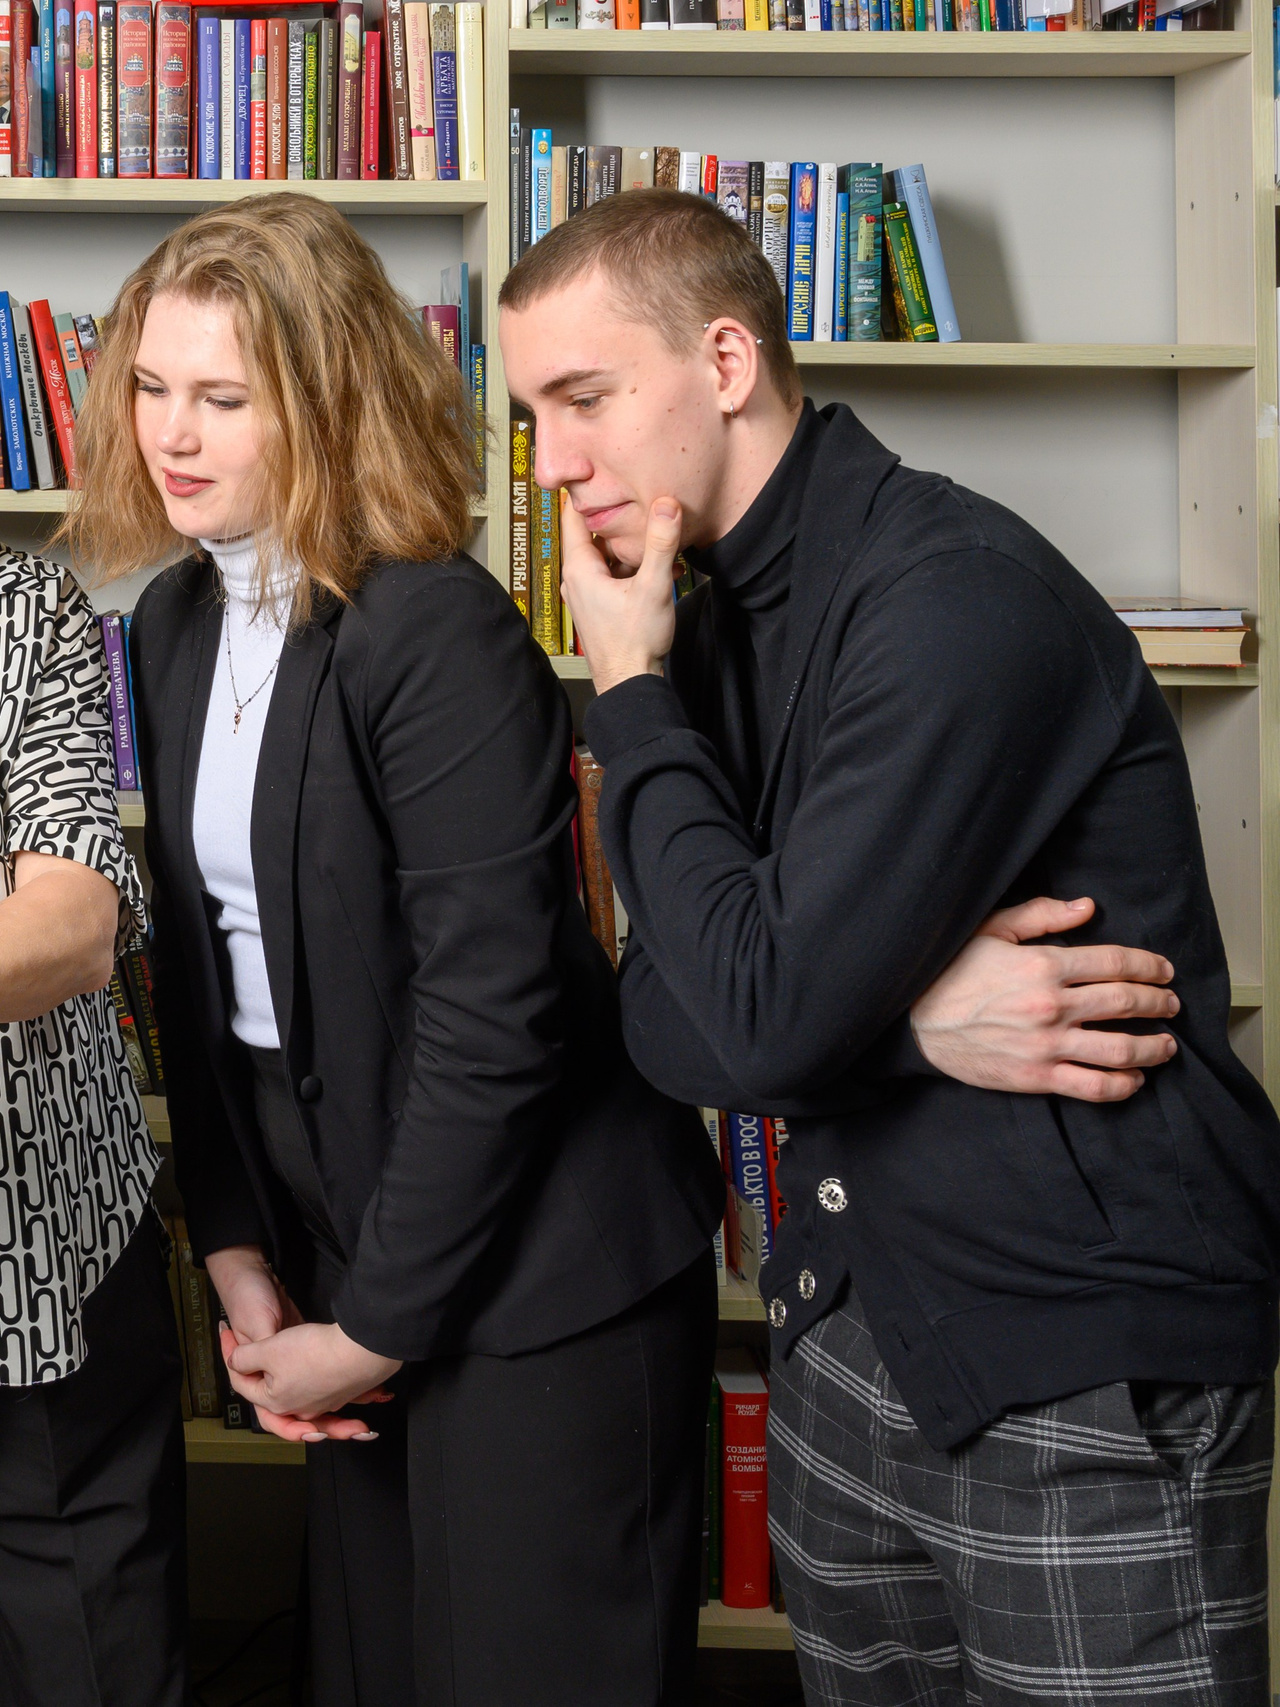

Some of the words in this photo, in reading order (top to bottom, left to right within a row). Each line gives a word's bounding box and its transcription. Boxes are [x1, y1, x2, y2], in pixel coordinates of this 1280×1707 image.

[222, 31, 231, 77] СЛОБОДЫ
[392, 19, 402, 68] открытие
[289, 40, 301, 96] ОТКРЫТКАХ
[307, 44, 315, 100] ОСТАНКИНО
[439, 56, 448, 95] АРБАТА
[221, 80, 231, 130] НЕМЕЦКОЙ
[222, 133, 230, 168] ВОКРУГ
[254, 102, 264, 175] РУБЛЕВКА
[289, 104, 302, 162] СОКОЛЬНИКИ
[537, 167, 549, 229] ПЕТРОДВОРЕЦ
[791, 280, 810, 333] ЦАРСКИЕ
[838, 282, 846, 318] ЦАРСКОЕ
[0, 308, 8, 339] МОСКВА
[2, 342, 12, 379] КНИЖНАЯ
[18, 333, 33, 374] Москвы
[9, 398, 21, 450] ЗАБОЛОТСКИХ
[26, 377, 44, 438] Открытие
[15, 452, 24, 471] Борис
[513, 481, 527, 517] ДОМ
[511, 522, 527, 591] РУССКИЙ
[111, 650, 125, 709] ГОРБАЧЕВА
[118, 714, 129, 748] РАИСА
[741, 1150, 761, 1161] В
[742, 1164, 765, 1195] КТО
[732, 1464, 763, 1472] БОМБЫ
